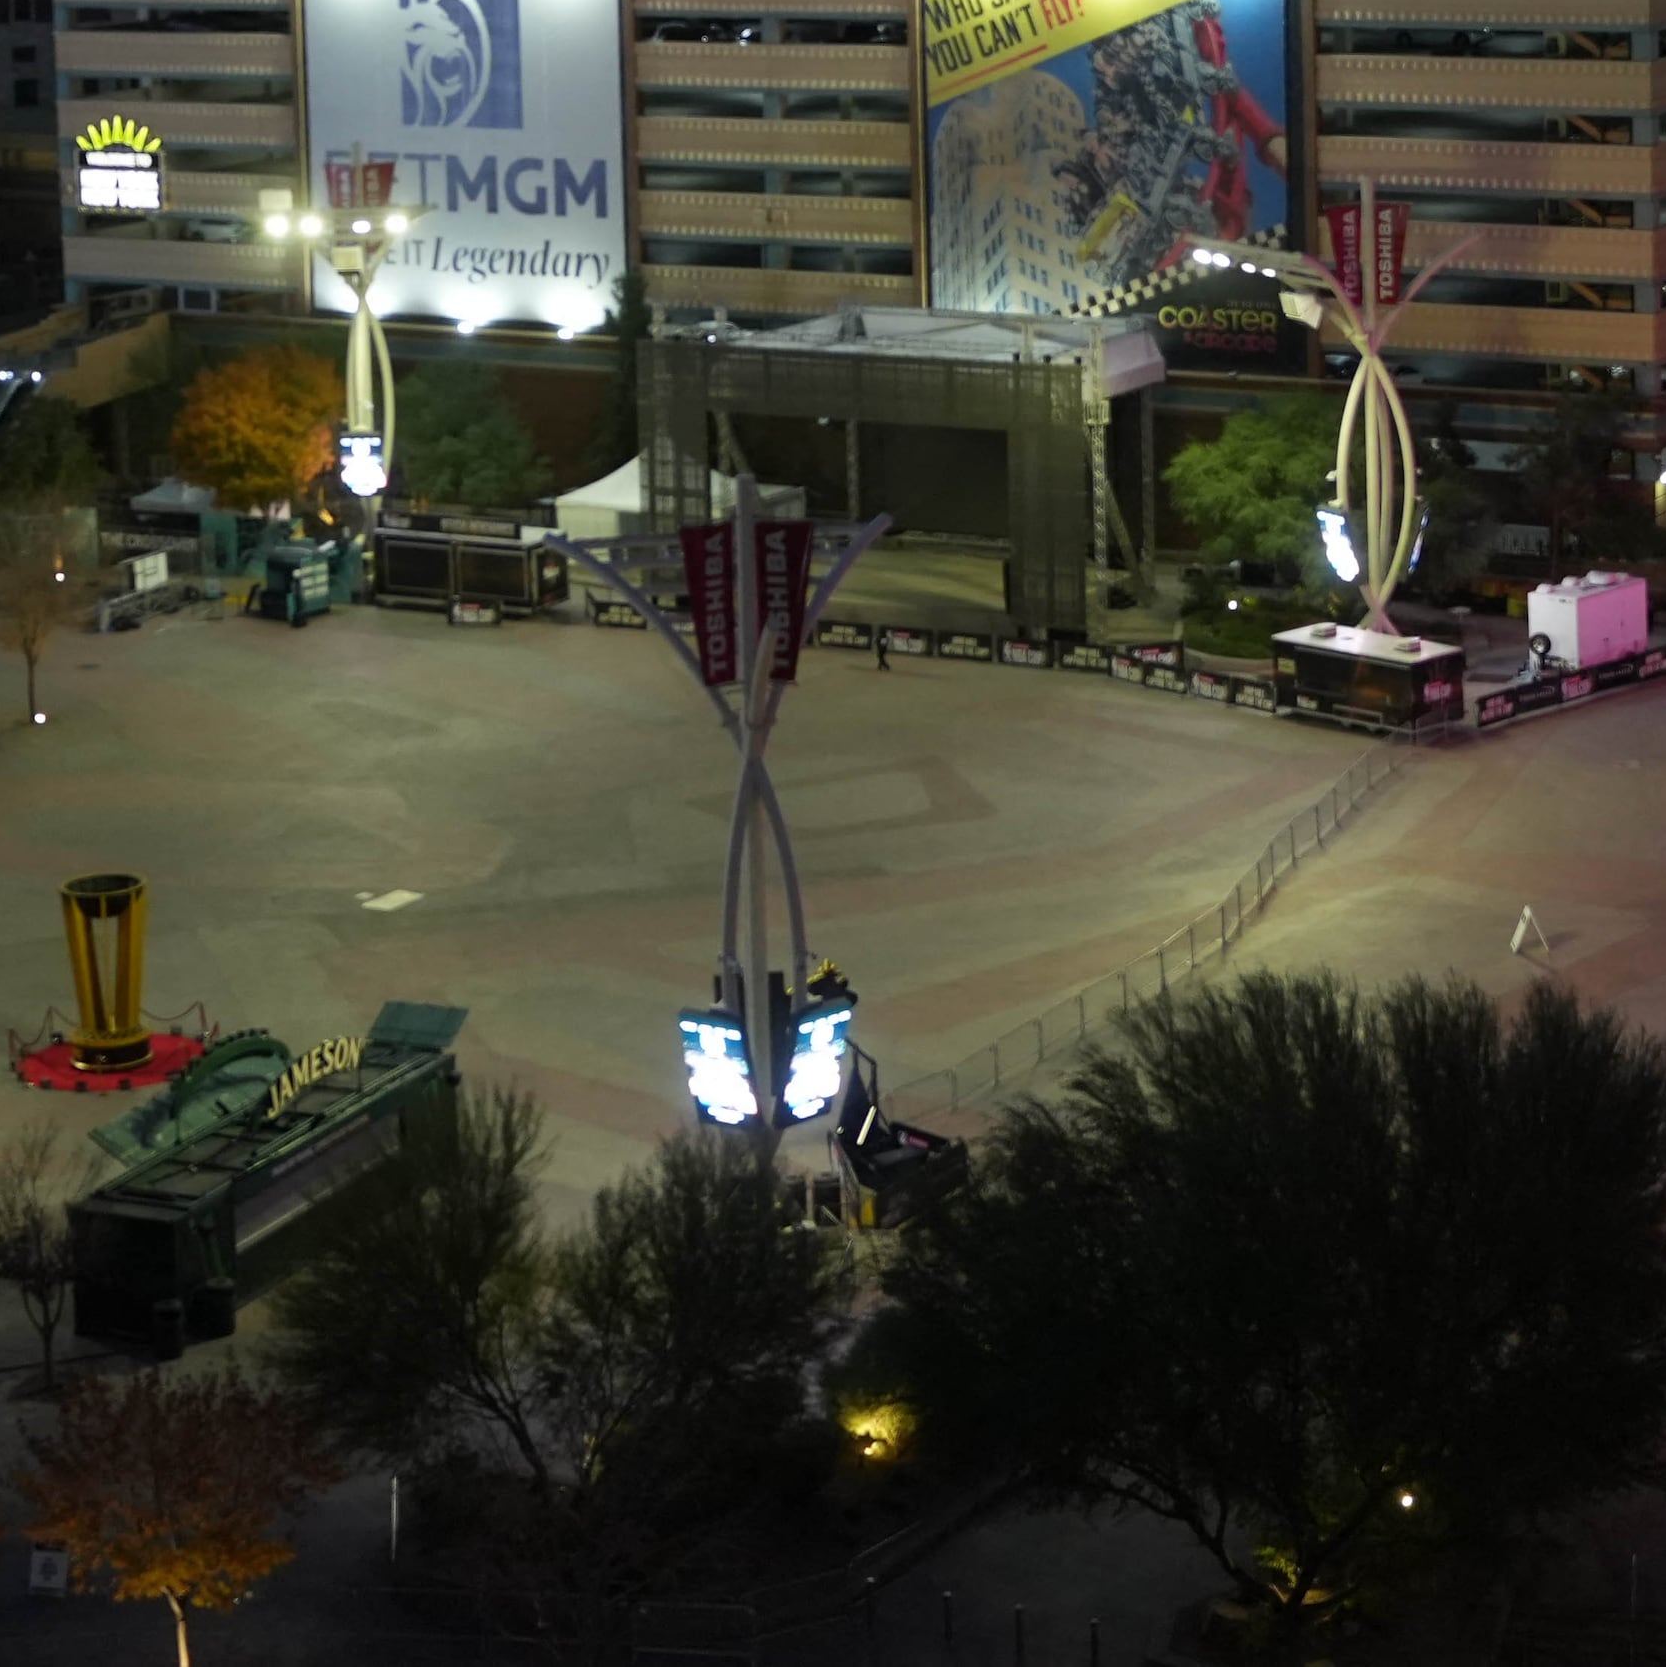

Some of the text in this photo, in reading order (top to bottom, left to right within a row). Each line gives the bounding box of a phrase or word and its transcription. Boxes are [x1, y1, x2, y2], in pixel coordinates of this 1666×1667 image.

[923, 33, 974, 87] YOU
[974, 4, 1038, 58] CAN'T
[430, 237, 610, 289] Legendary
[1378, 209, 1395, 300] TOSHIBA
[702, 530, 729, 678] TOSHIBA
[267, 1035, 364, 1119] JAMESON
